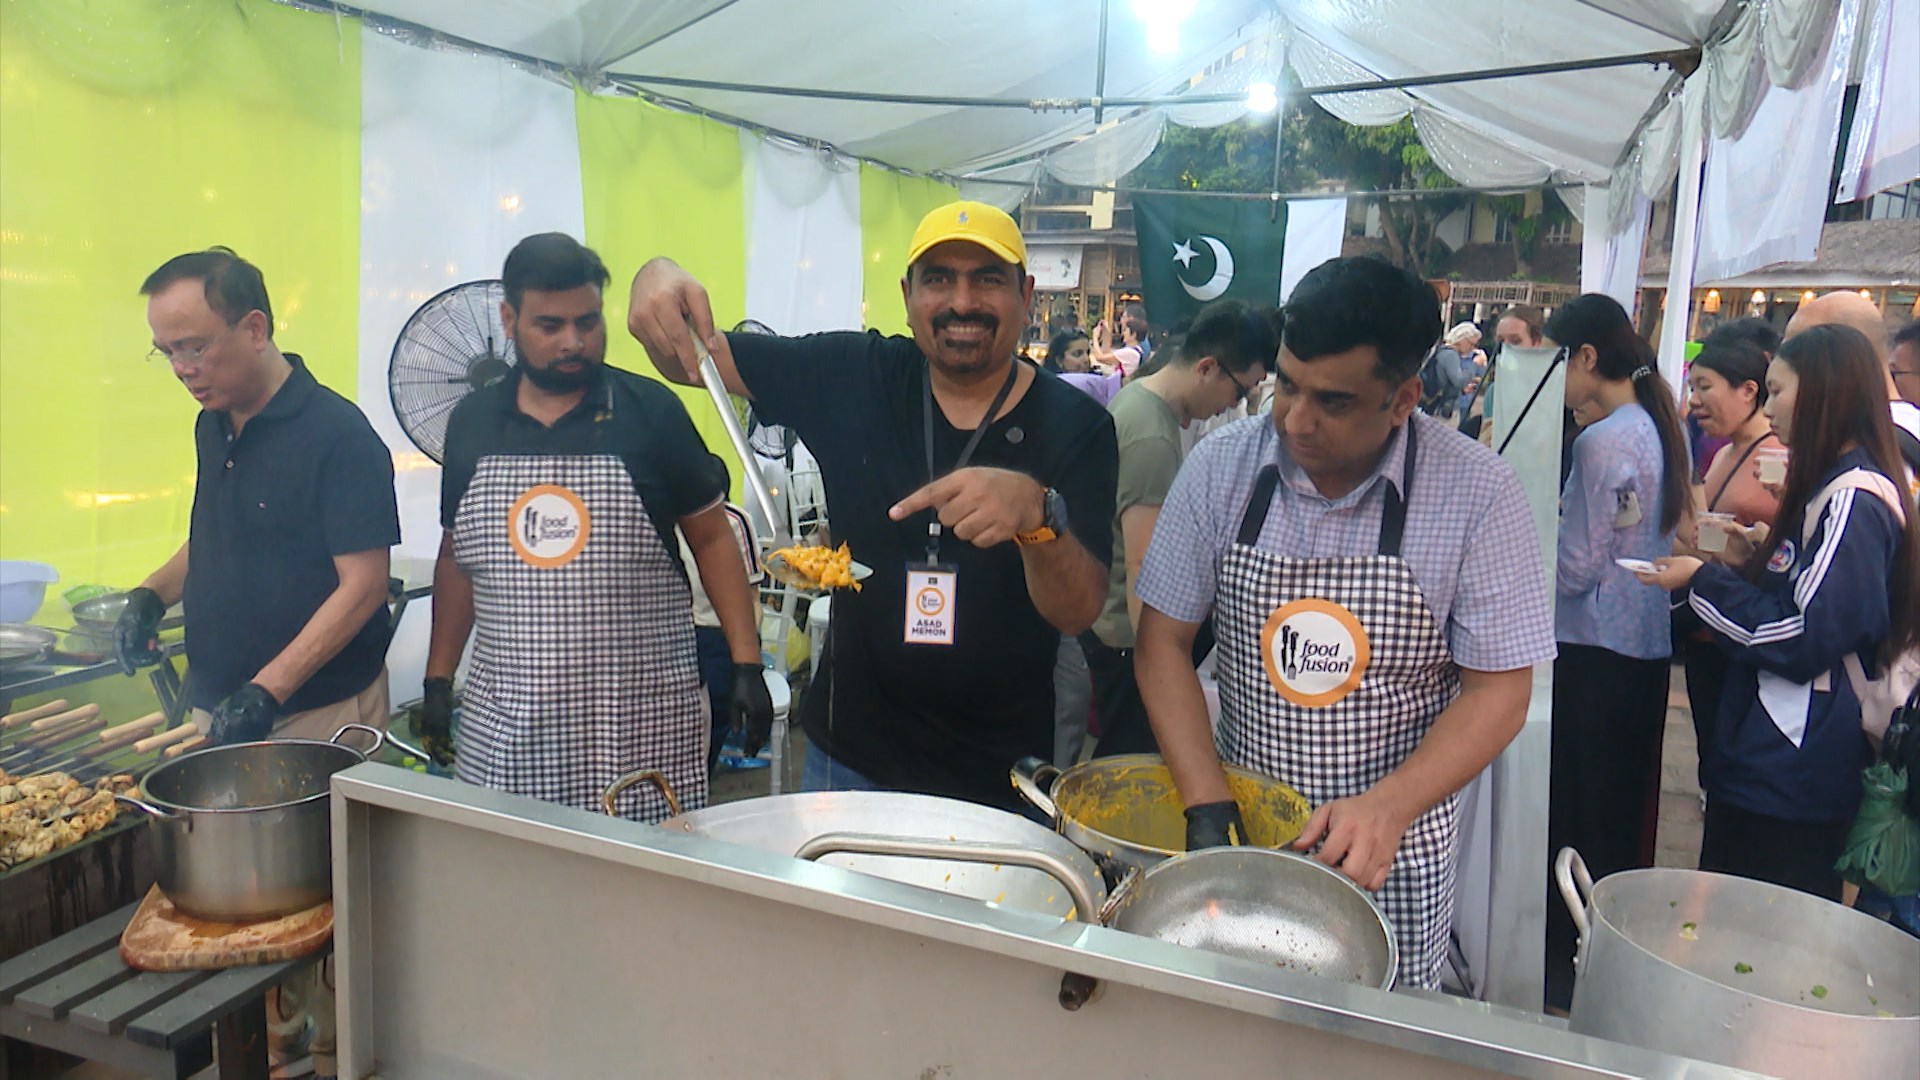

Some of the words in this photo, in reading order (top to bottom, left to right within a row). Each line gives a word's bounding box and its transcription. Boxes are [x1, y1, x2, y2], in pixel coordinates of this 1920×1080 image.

[917, 619, 942, 628] ASAD
[912, 627, 946, 636] MEMON
[1300, 639, 1340, 658] food
